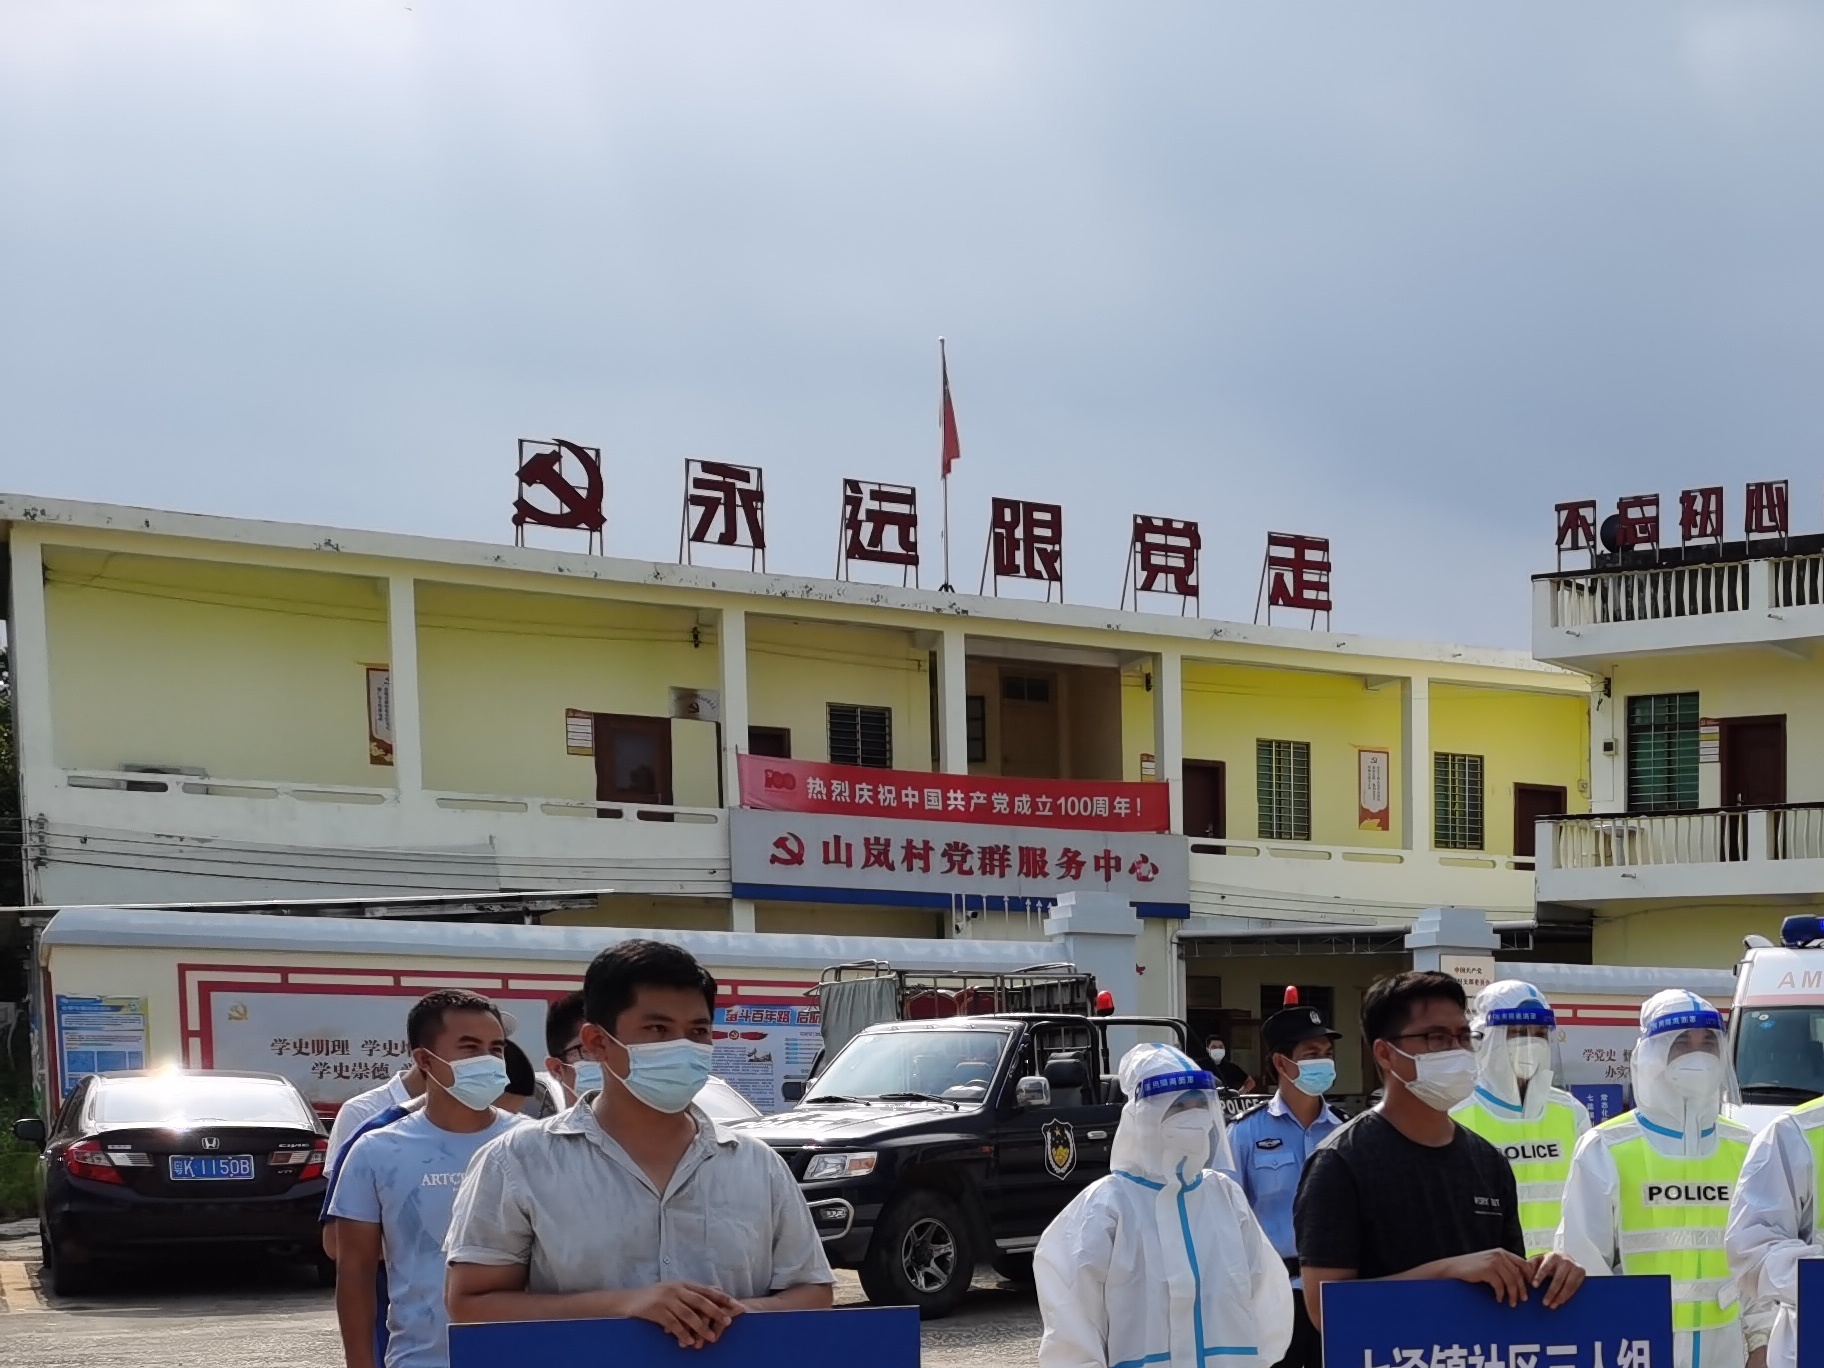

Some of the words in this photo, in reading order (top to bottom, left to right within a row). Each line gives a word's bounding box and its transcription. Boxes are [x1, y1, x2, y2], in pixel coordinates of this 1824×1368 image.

[688, 460, 1333, 612] 永远跟党走
[821, 831, 1160, 883] 山岚村党群服务中心
[270, 1037, 351, 1057] 学史明理
[311, 1061, 391, 1081] 学史崇德
[1505, 1144, 1559, 1159] OLICE
[1648, 1184, 1730, 1203] POLICE
